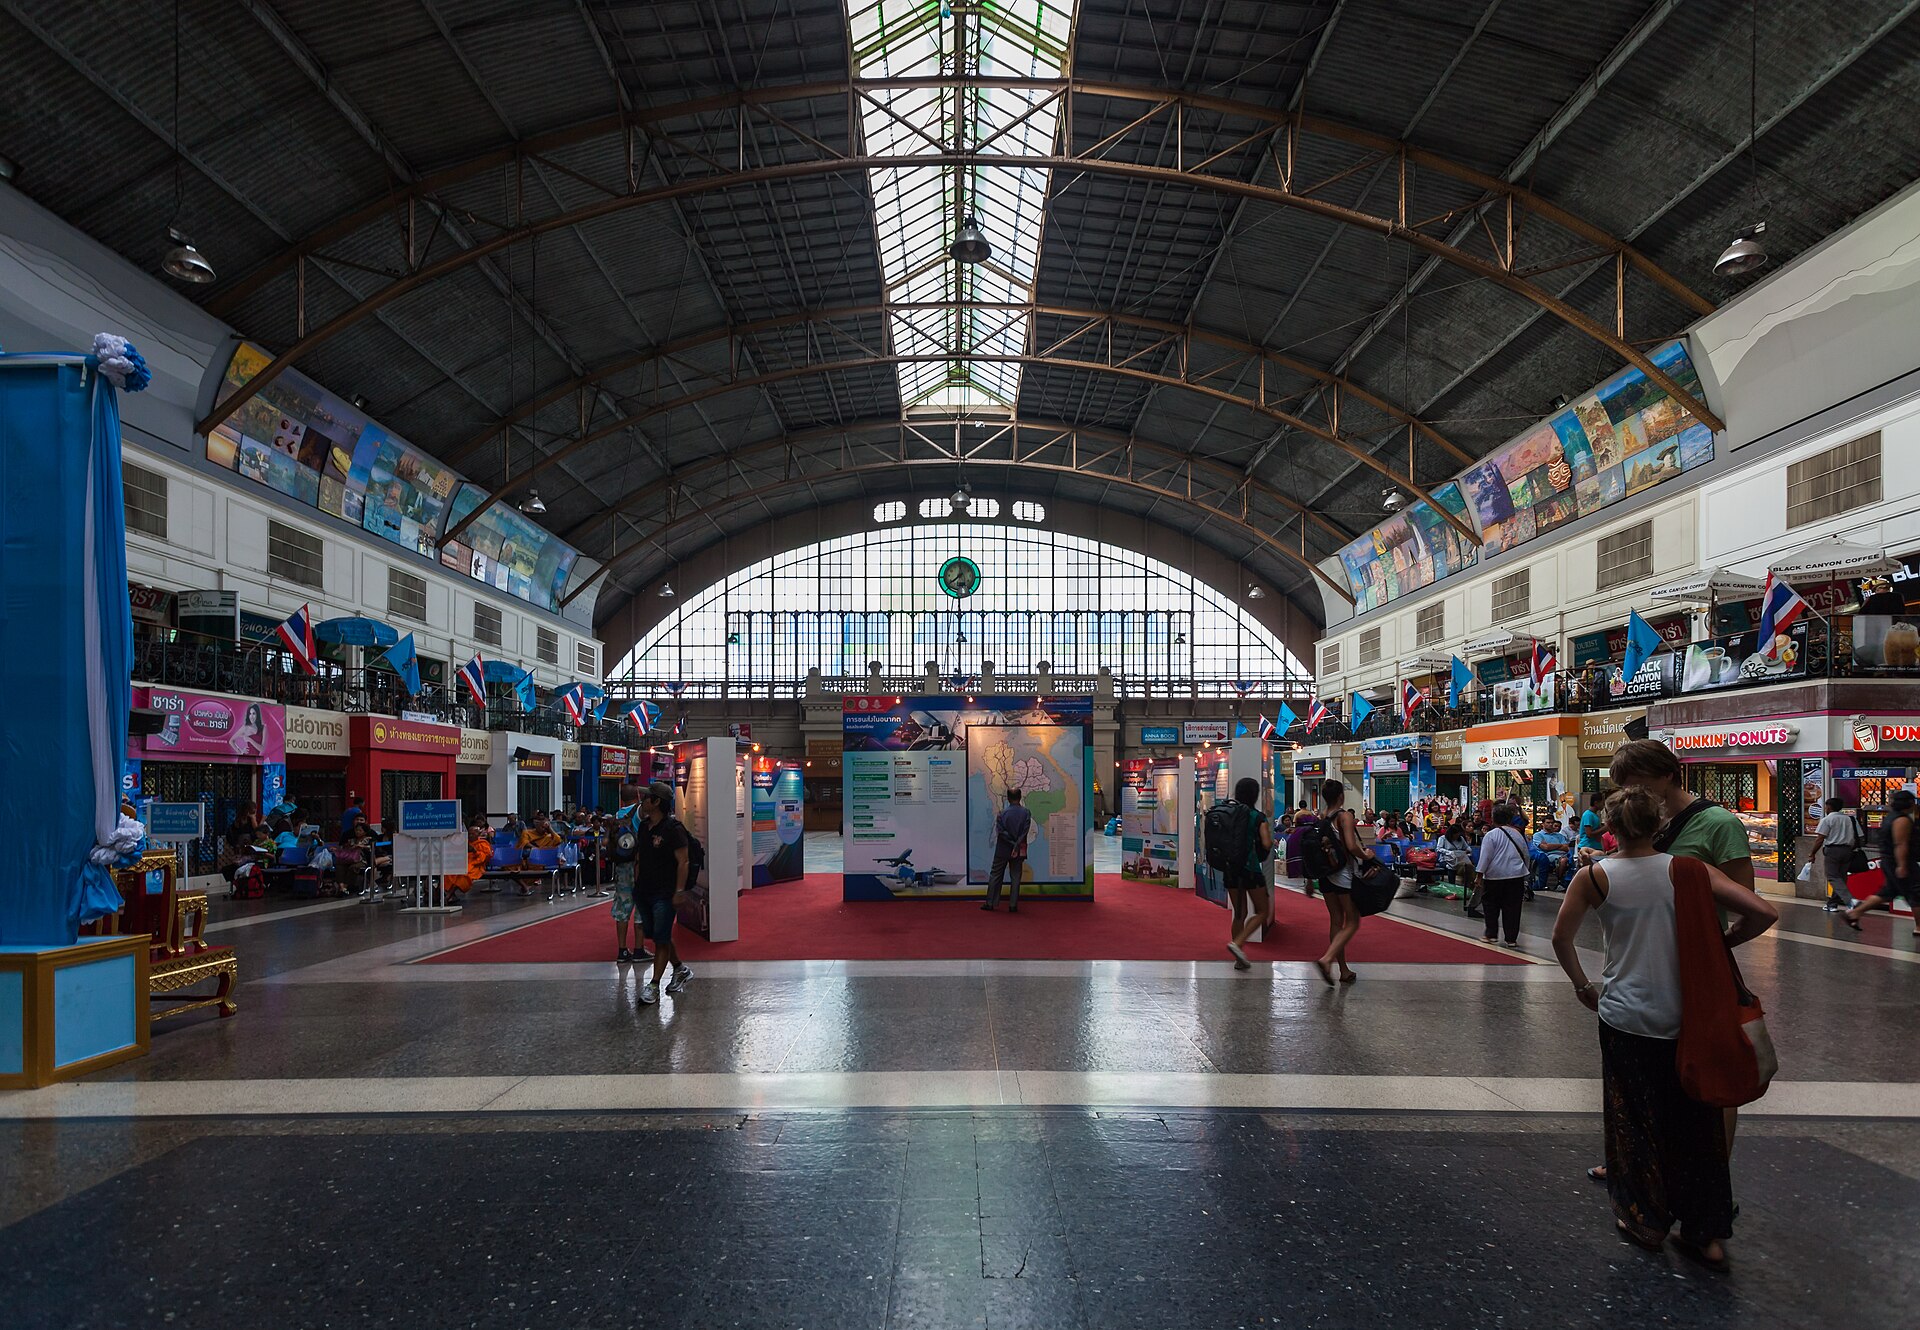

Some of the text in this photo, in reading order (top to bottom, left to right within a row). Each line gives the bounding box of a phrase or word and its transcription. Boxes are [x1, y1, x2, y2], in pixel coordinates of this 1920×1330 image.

[1773, 553, 1880, 574] BLACK CANYON COFFEE
[1575, 639, 1599, 651] OURIST
[1627, 681, 1662, 694] COFFEE
[152, 694, 184, 711] ซาร่า
[287, 740, 337, 751] FOOD COURT
[1675, 729, 1787, 750] DUNKIN' DONUTS
[1492, 746, 1528, 758] KUDSAN
[1583, 740, 1615, 752] Grocery
[470, 753, 485, 761] COURT
[1435, 752, 1453, 762] Grocery
[1492, 758, 1507, 767] Bakery
[1514, 757, 1528, 766] Coffee
